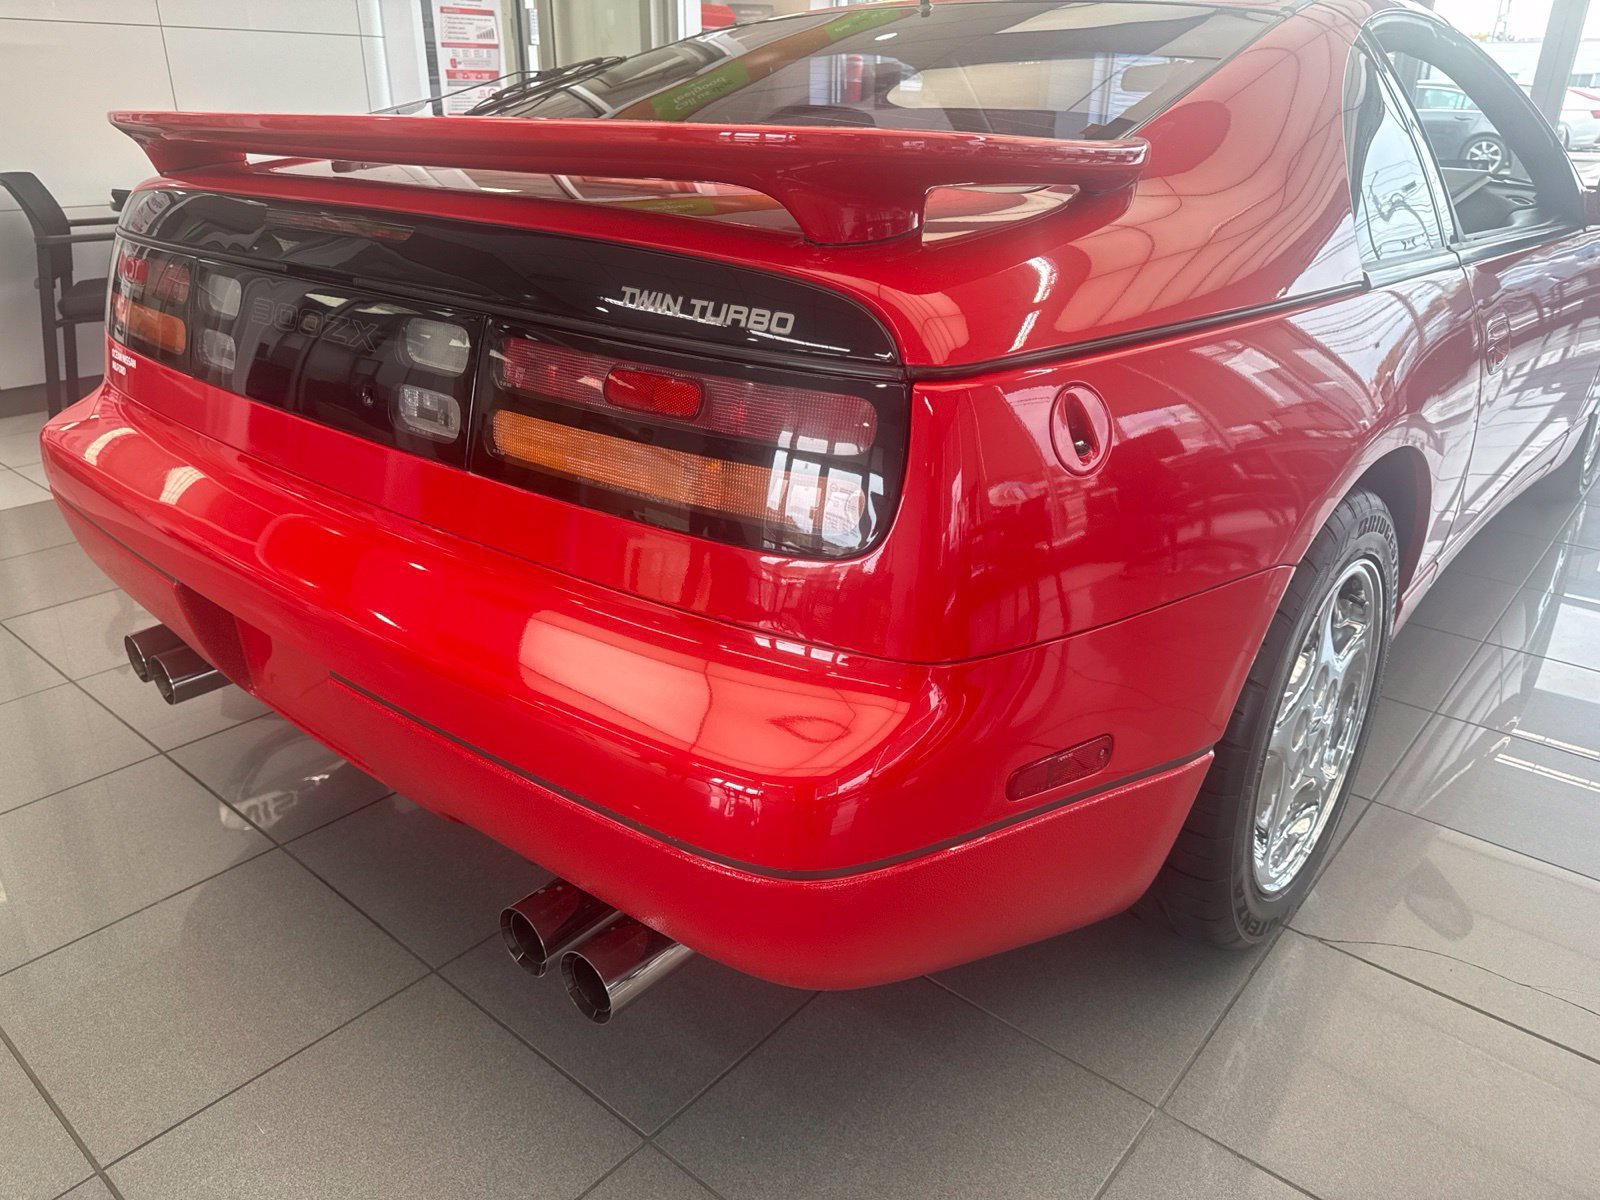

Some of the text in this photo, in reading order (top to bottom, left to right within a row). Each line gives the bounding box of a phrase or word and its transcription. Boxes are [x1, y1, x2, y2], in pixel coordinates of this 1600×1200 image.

[252, 297, 379, 354] 300ZX
[621, 286, 795, 335] TWIN TURBO
